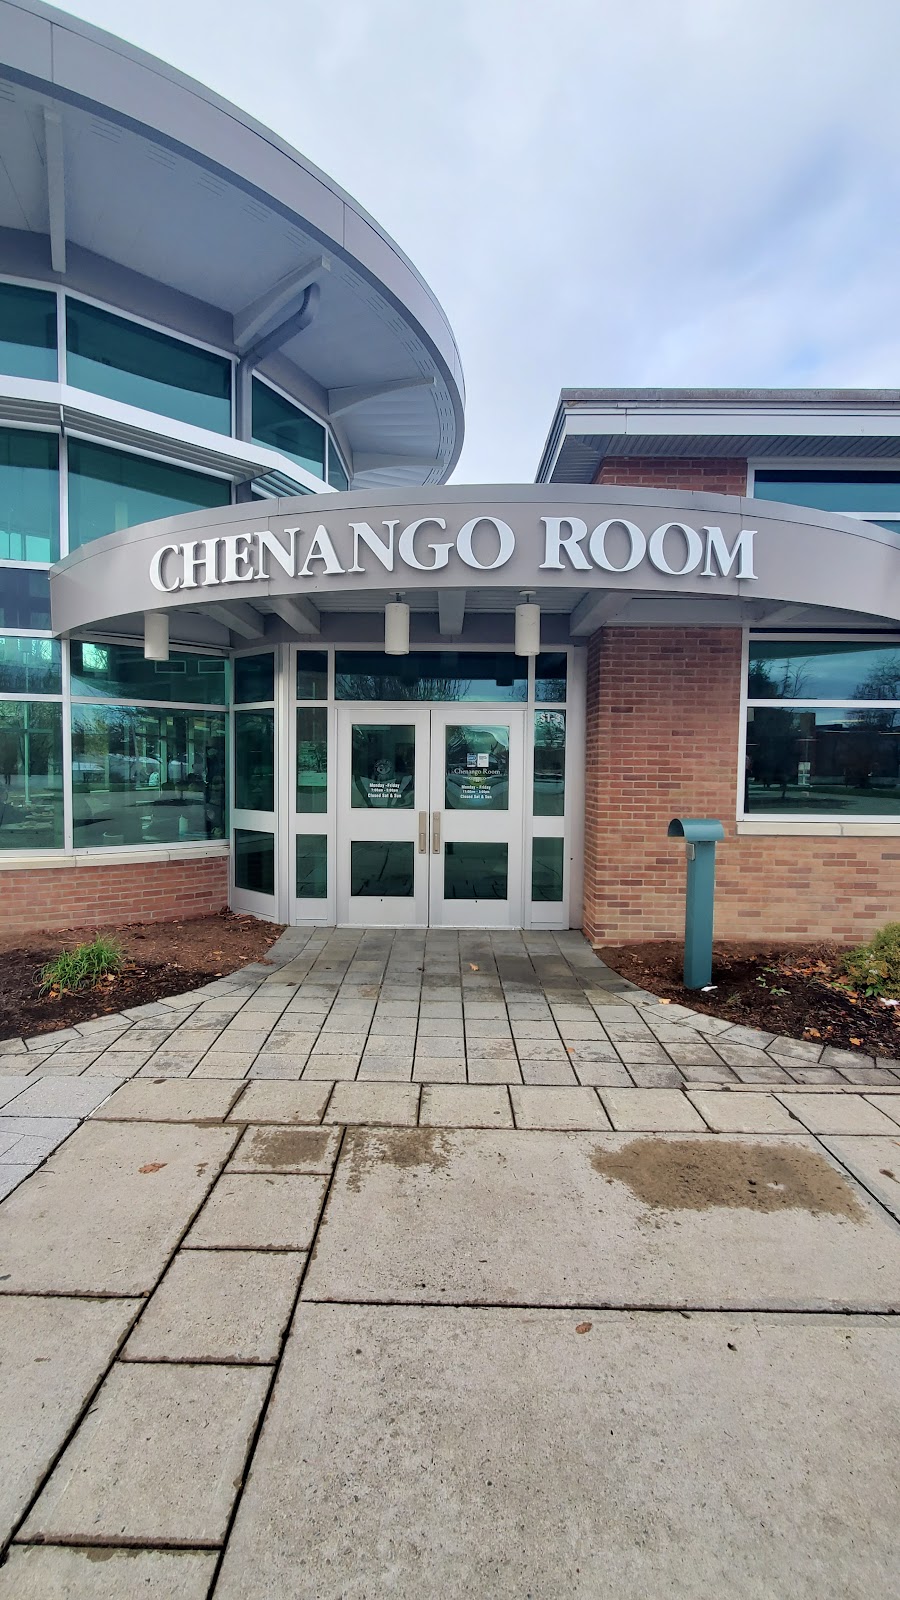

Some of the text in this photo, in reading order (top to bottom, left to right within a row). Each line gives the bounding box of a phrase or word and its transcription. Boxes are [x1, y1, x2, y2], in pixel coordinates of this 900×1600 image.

[149, 515, 759, 594] CHENANGO ROOM
[454, 768, 481, 776] Chenango
